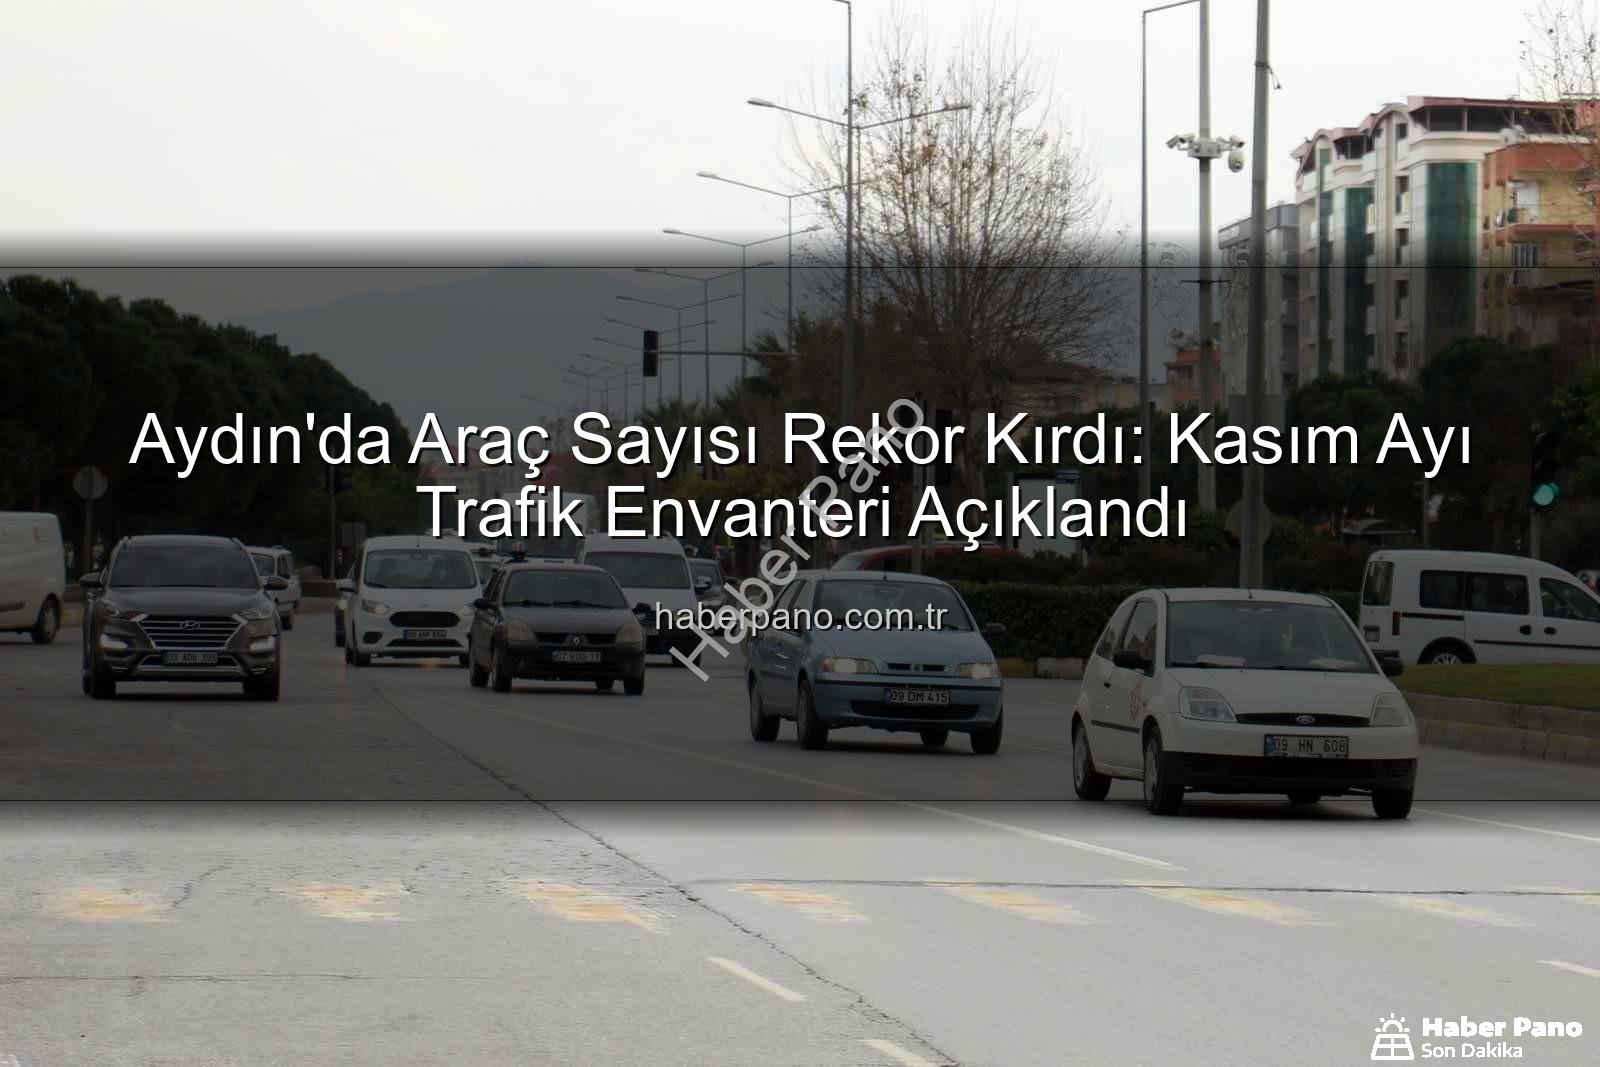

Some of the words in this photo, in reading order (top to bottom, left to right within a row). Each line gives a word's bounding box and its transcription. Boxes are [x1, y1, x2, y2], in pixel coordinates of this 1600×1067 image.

[890, 690, 904, 702] 09
[908, 691, 924, 702] DM
[928, 692, 948, 703] 415
[1274, 738, 1288, 752] 09
[1299, 738, 1314, 753] HN
[1324, 739, 1346, 753] 608
